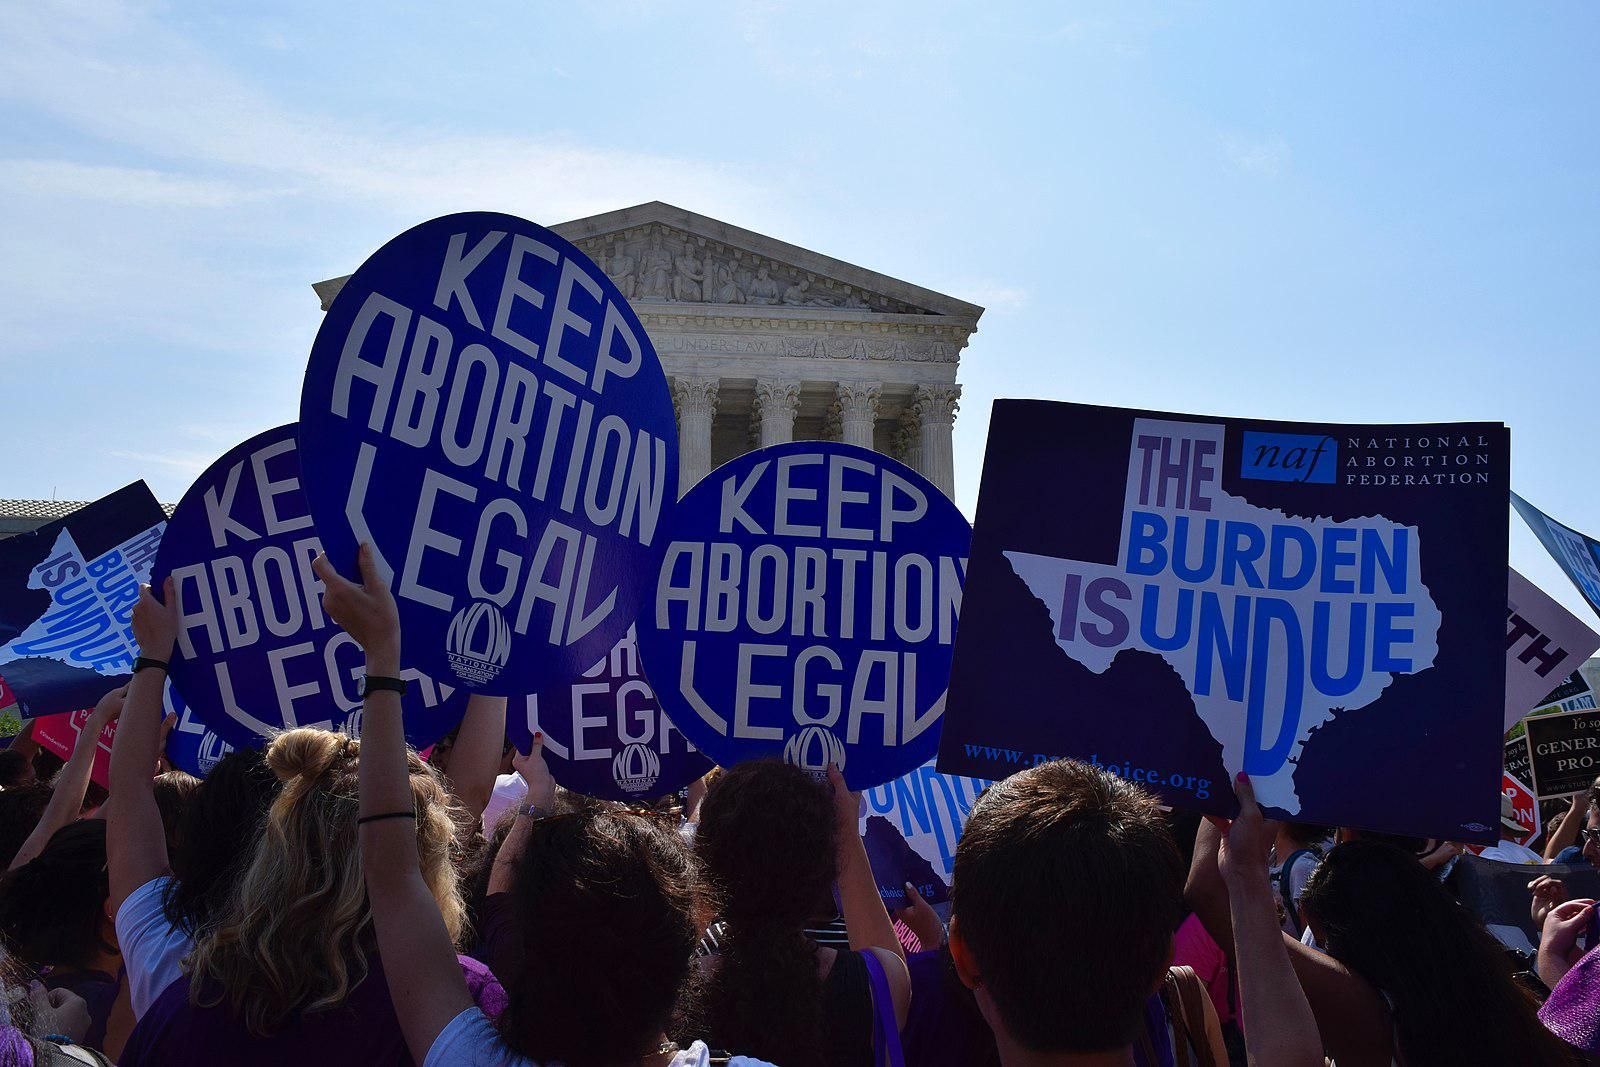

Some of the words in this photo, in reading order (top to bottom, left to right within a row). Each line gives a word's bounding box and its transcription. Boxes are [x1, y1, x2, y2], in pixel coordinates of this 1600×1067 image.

[433, 230, 642, 394] KEEP
[673, 338, 729, 352] UNDER
[737, 339, 768, 353] LAW
[331, 291, 666, 547] ABORTION
[1347, 435, 1489, 450] NATIONAL
[203, 438, 315, 549] KE
[1137, 435, 1217, 512] THE
[1253, 435, 1338, 484] naf
[1346, 453, 1489, 468] ABORTION
[1346, 472, 1489, 487] FEDERATION
[719, 453, 928, 542] KEEP
[35, 551, 81, 588] IS
[345, 441, 619, 646] LEGAL
[1125, 511, 1409, 595] BURDEN
[11, 576, 134, 671] UNDUE
[171, 536, 339, 660] ABOR
[446, 602, 512, 666] NOW
[448, 655, 500, 673] NATIONAL
[1057, 573, 1133, 648] IS
[1139, 584, 1415, 777] UNDUE
[1506, 608, 1569, 678] TH
[679, 640, 948, 747] LEGAL
[1572, 718, 1586, 730] Yo
[1589, 719, 1600, 732] so
[612, 743, 660, 780] NOW
